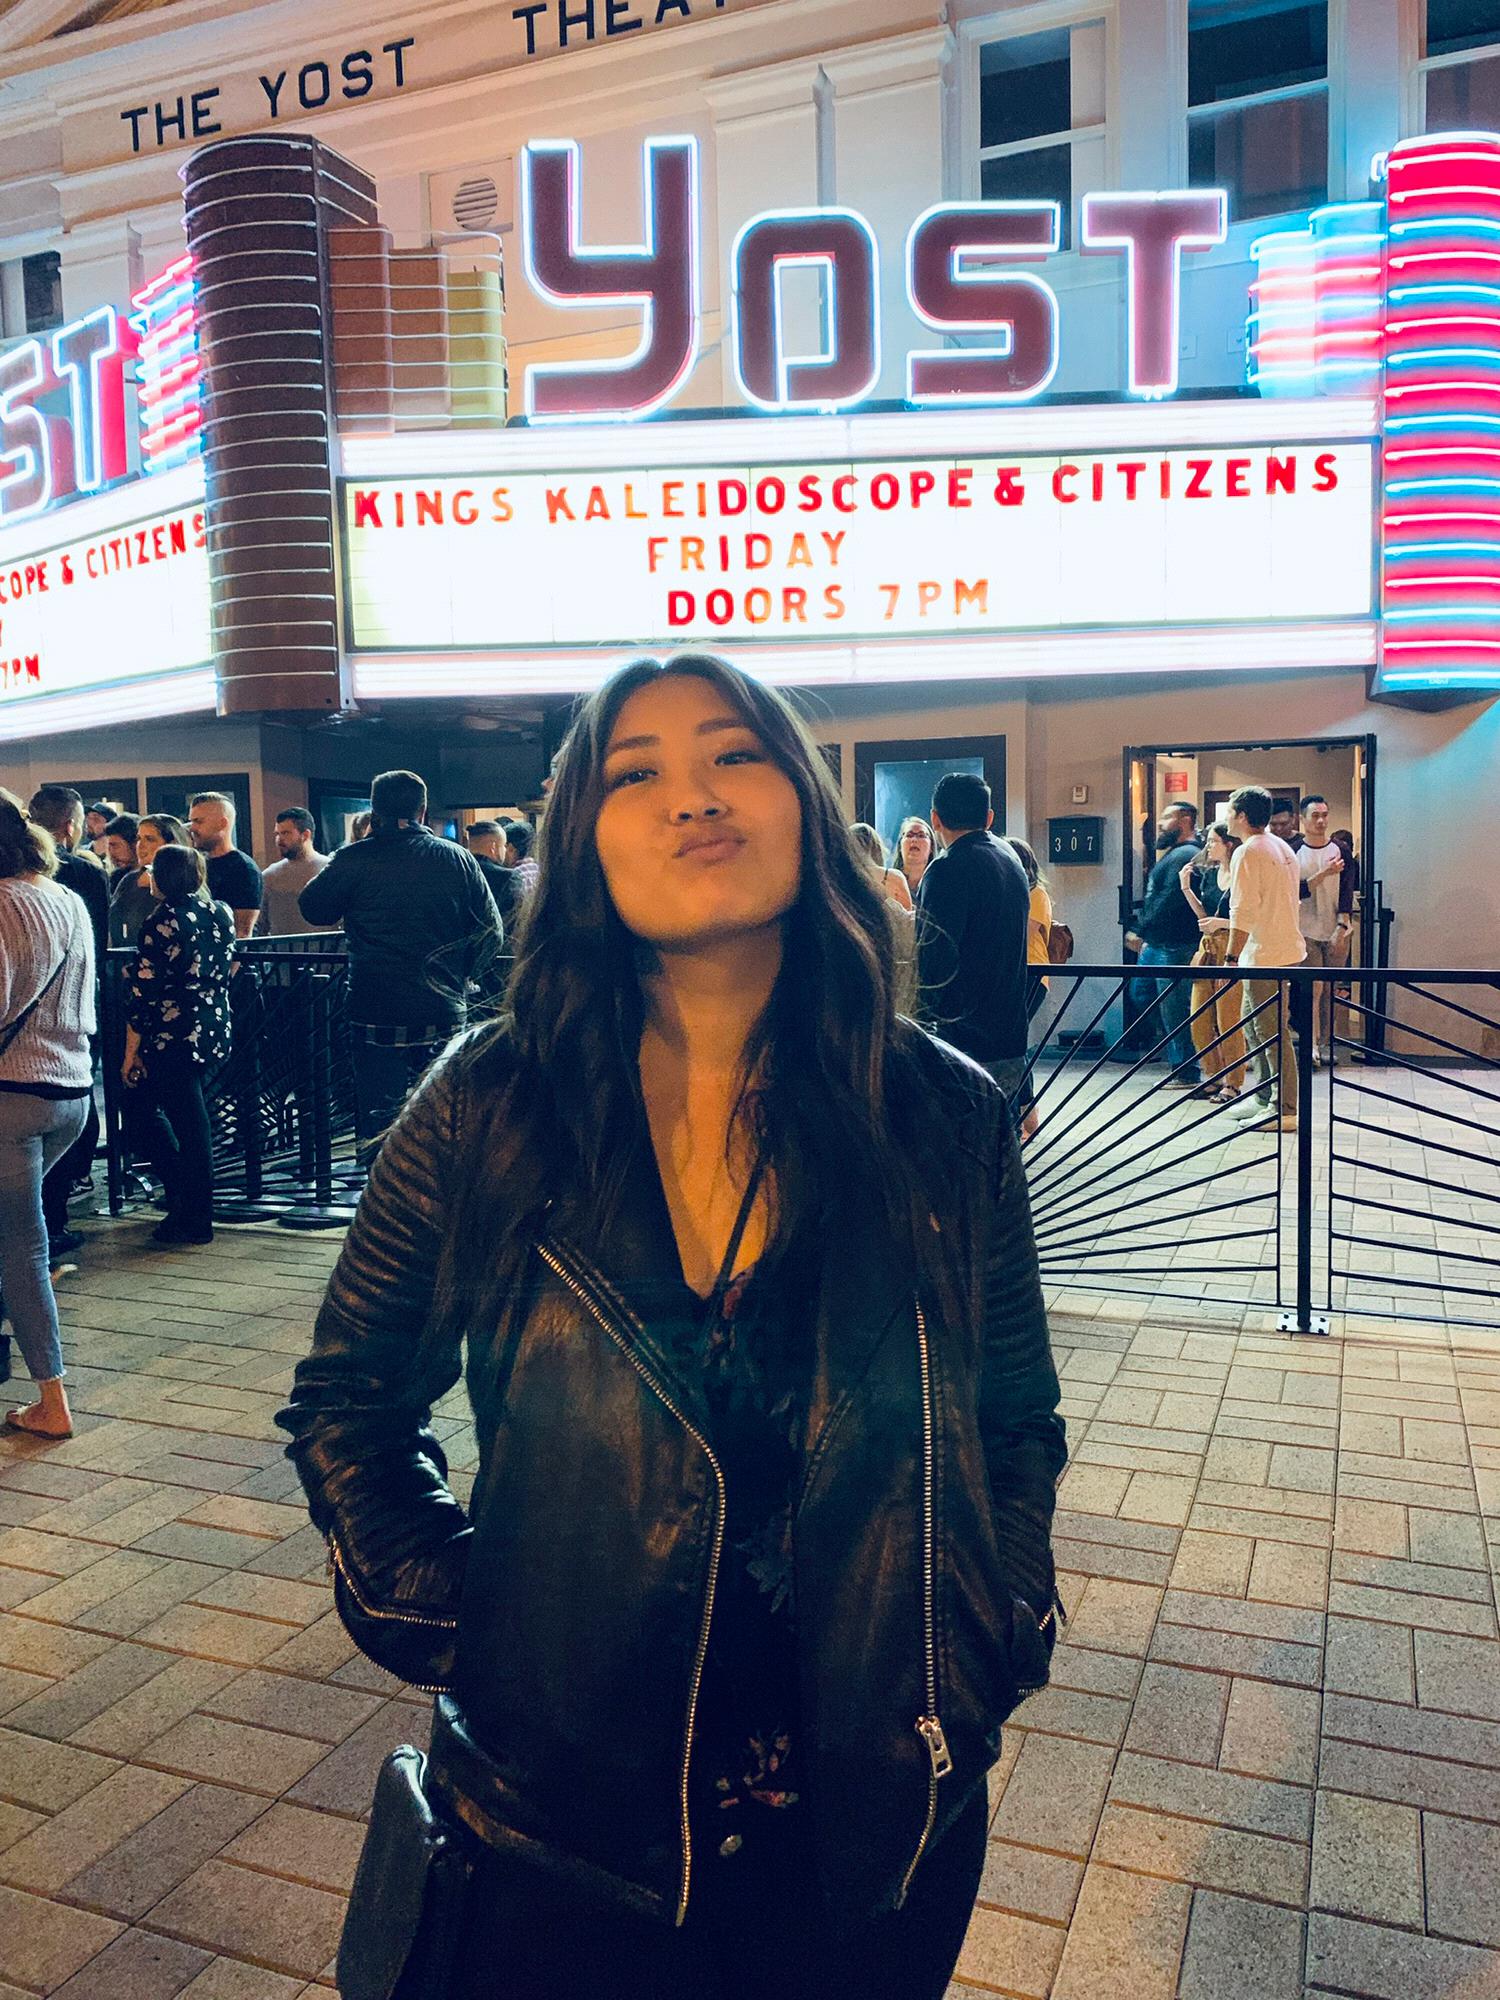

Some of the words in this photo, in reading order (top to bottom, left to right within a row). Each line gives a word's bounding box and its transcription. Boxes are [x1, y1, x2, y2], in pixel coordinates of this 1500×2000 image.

[120, 87, 222, 152] THE
[258, 37, 415, 119] YOST
[520, 133, 1230, 426] YOST
[353, 487, 514, 529] KINGS
[545, 467, 974, 525] KALEIDOSCOPE
[994, 466, 1025, 507] &
[1052, 453, 1339, 504] CITIZENS
[60, 554, 75, 586] &
[86, 513, 206, 579] CITIZENS
[647, 530, 846, 574] FRIDAY
[667, 583, 845, 627] DOORS
